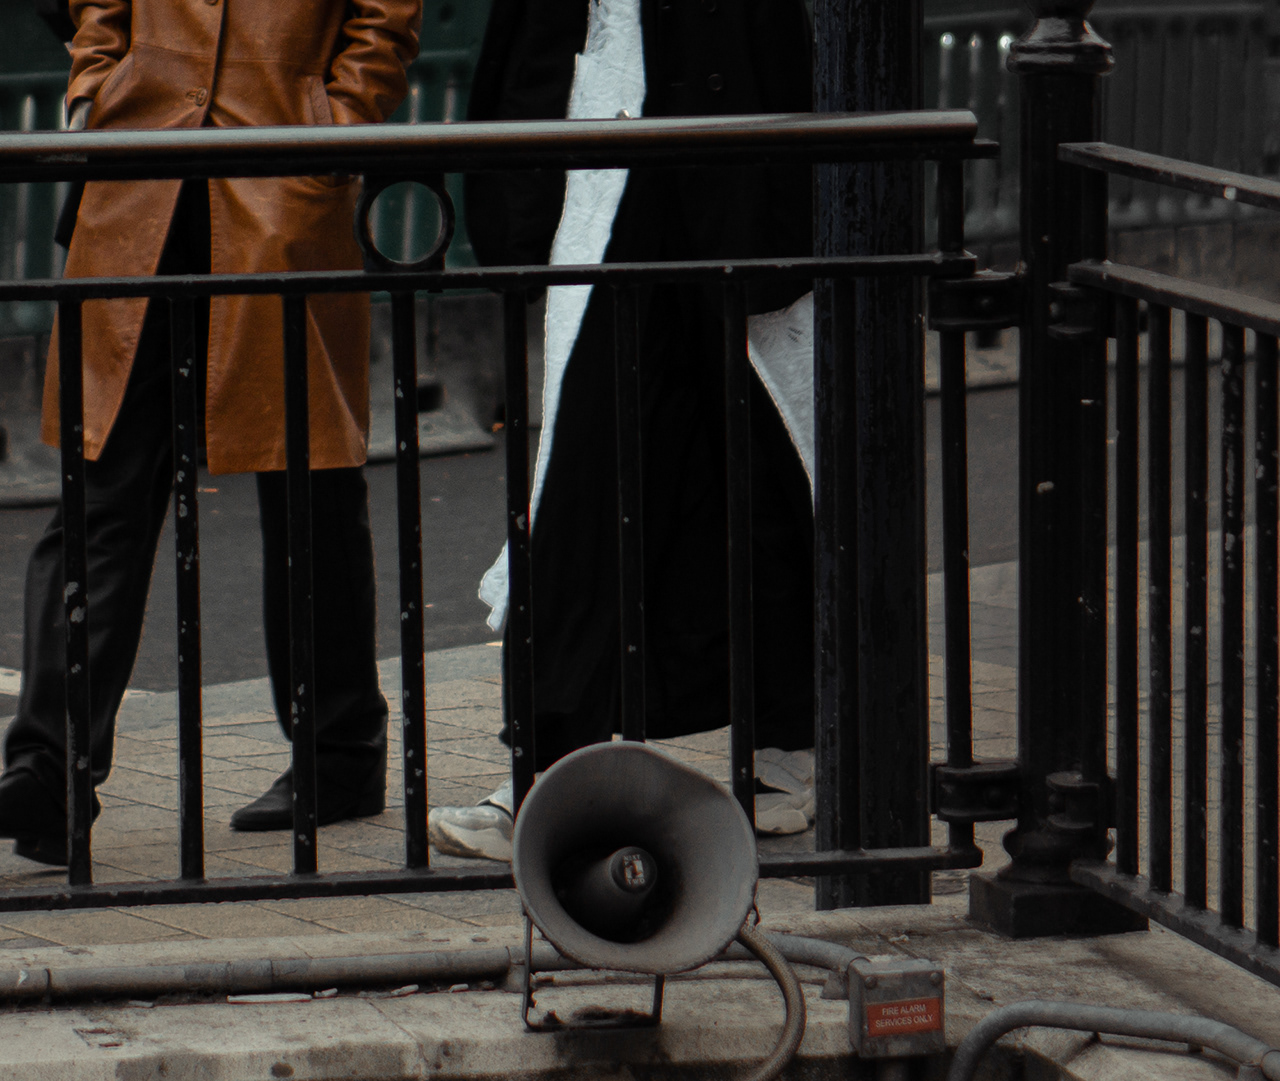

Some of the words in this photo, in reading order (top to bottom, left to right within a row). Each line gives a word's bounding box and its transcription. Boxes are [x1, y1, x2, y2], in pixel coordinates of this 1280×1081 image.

[882, 1007, 899, 1015] FIRE
[901, 1004, 926, 1014] ALARM
[875, 1016, 912, 1028] SERVICES
[914, 1014, 933, 1023] ONLY
